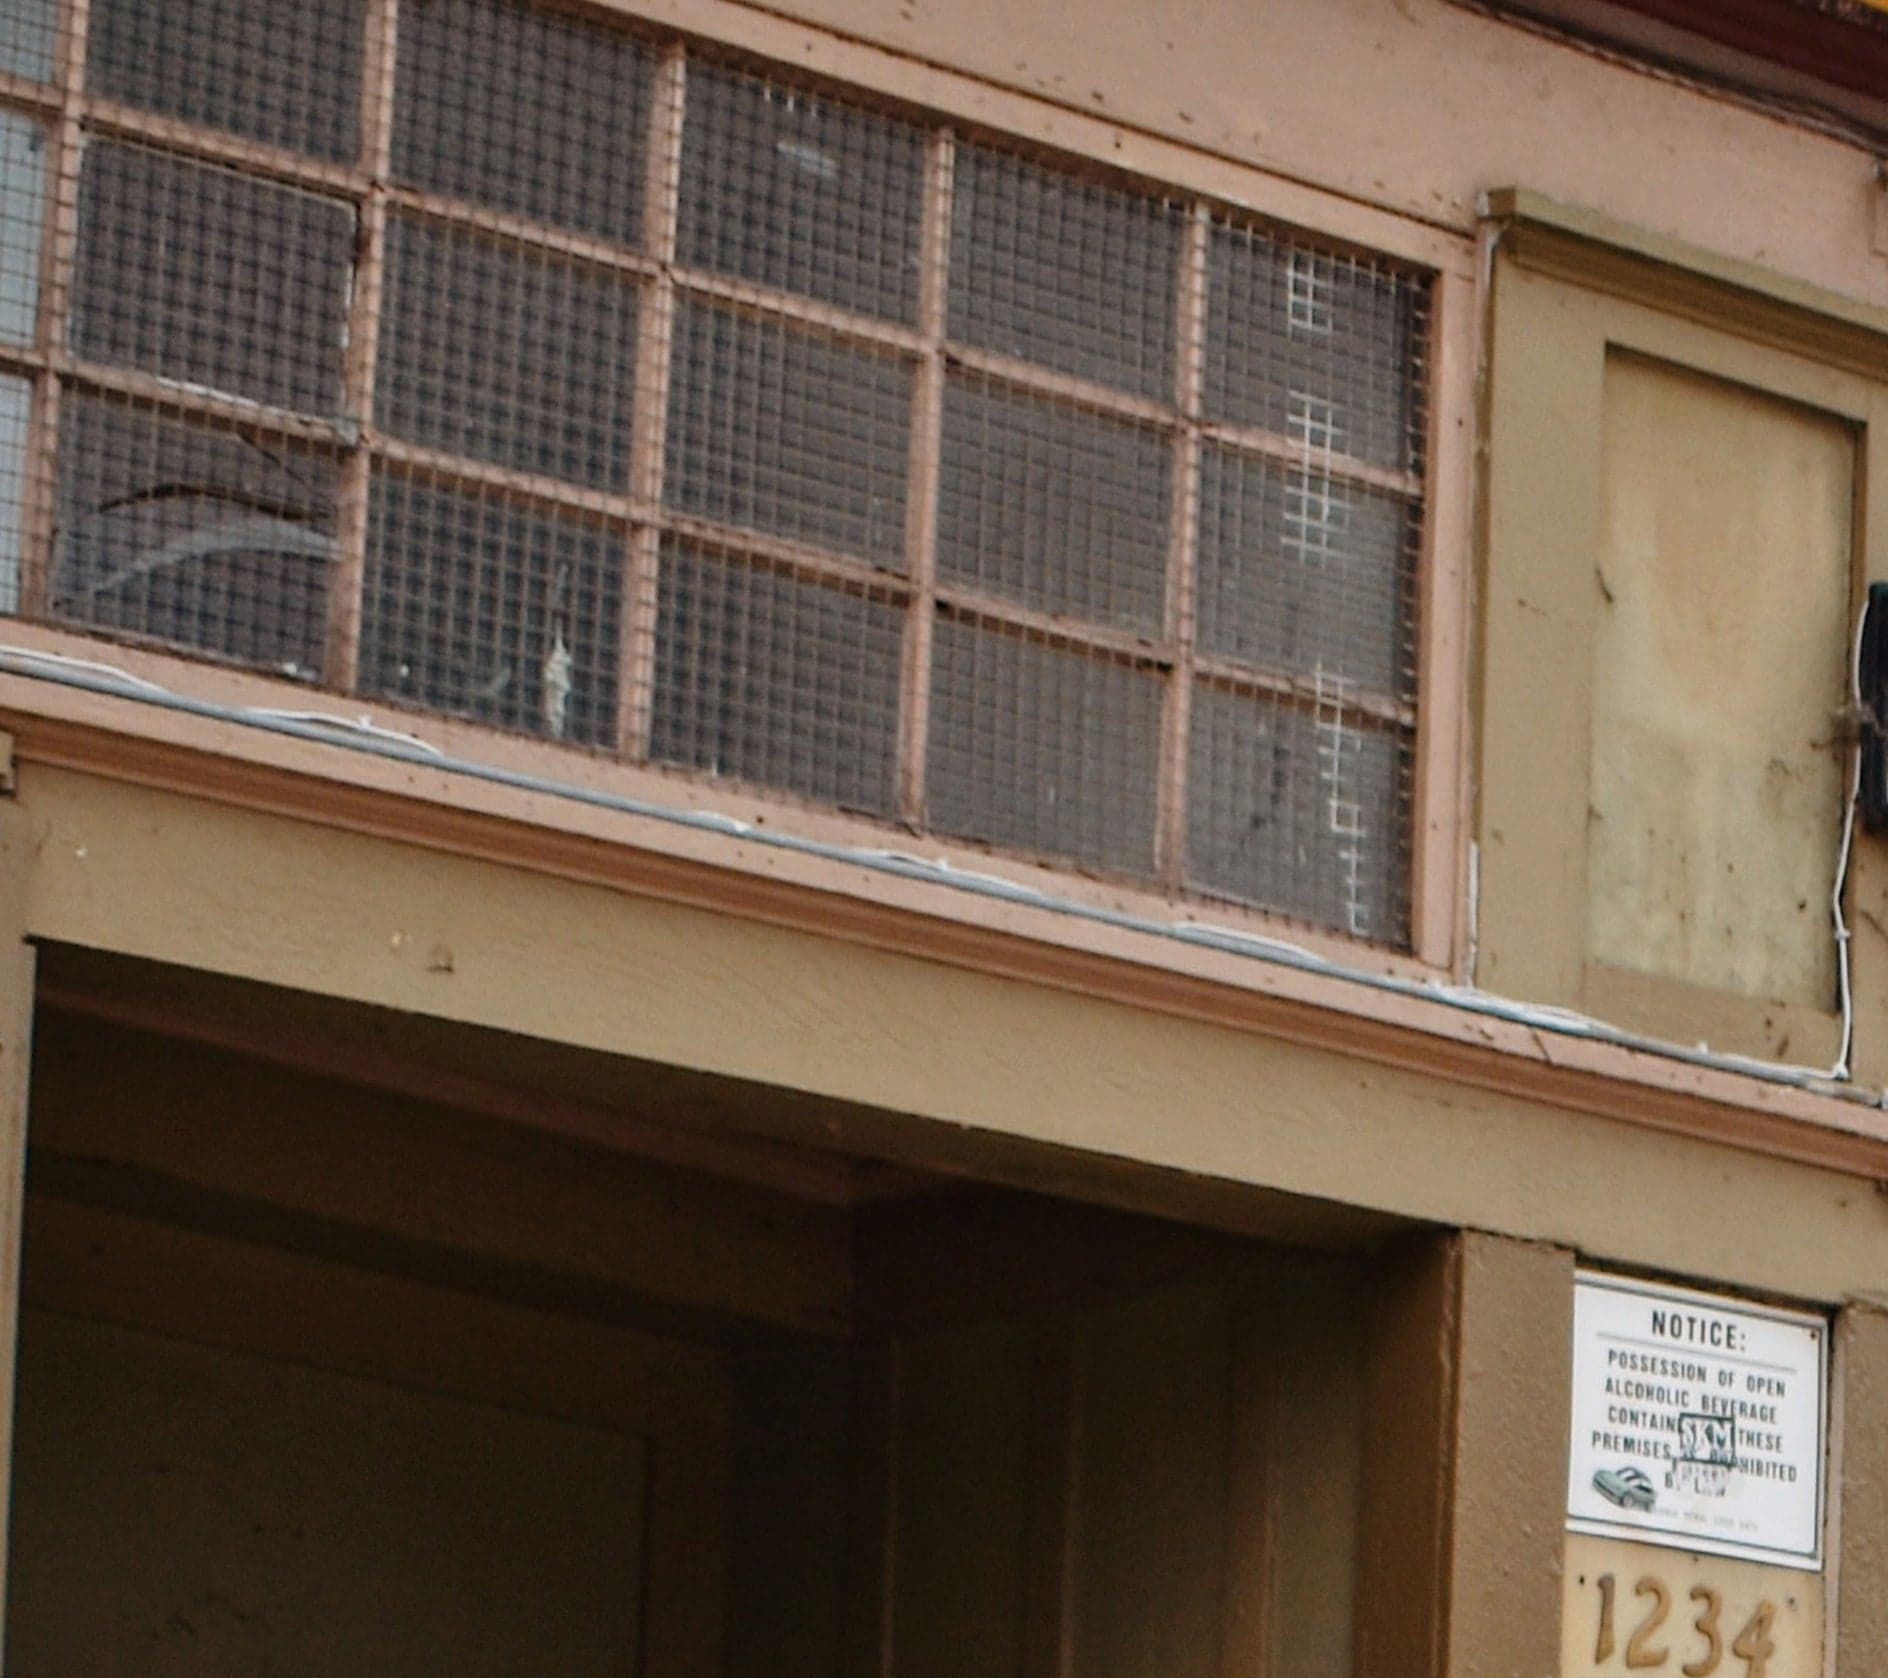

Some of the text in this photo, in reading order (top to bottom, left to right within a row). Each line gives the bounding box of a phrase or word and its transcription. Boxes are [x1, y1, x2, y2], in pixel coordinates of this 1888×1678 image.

[1650, 1310, 1748, 1352] NOTICE:
[1607, 1348, 1786, 1399] POSSESSION OF OPEN
[1604, 1377, 1778, 1424] ALCOHOLIC BEVERAGE
[1591, 1432, 1672, 1460] PREMISES
[1738, 1428, 1784, 1453] THESE
